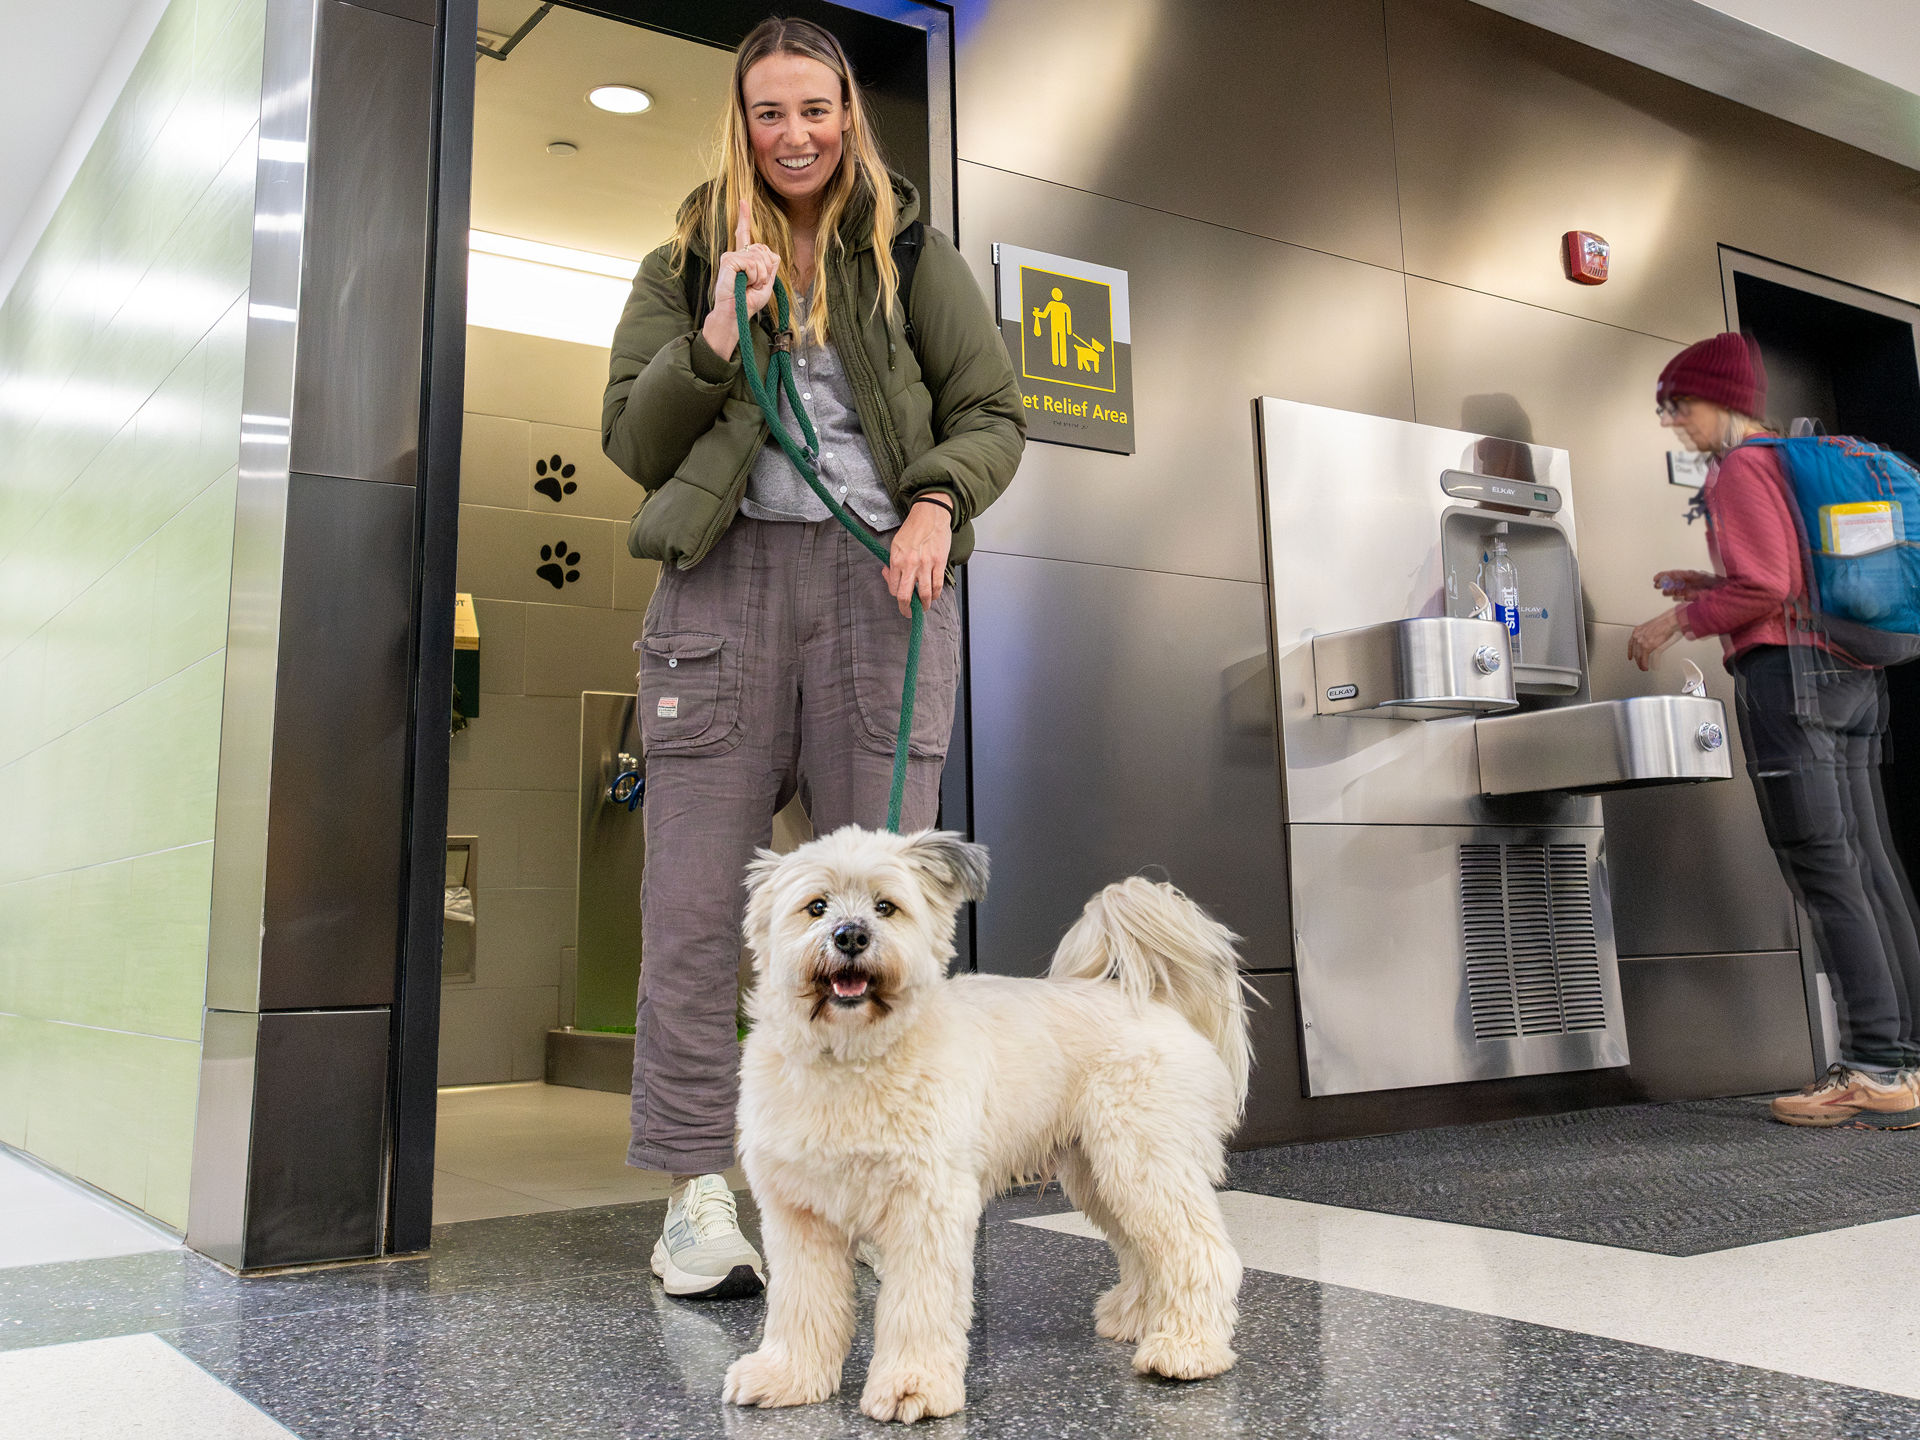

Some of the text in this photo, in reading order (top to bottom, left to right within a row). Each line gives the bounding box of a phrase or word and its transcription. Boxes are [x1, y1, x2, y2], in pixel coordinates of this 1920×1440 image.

[1020, 393, 1128, 425] et Relief Area
[1491, 486, 1516, 496] ELKAY
[1502, 587, 1516, 629] smart
[1329, 687, 1355, 697] ELKAY
